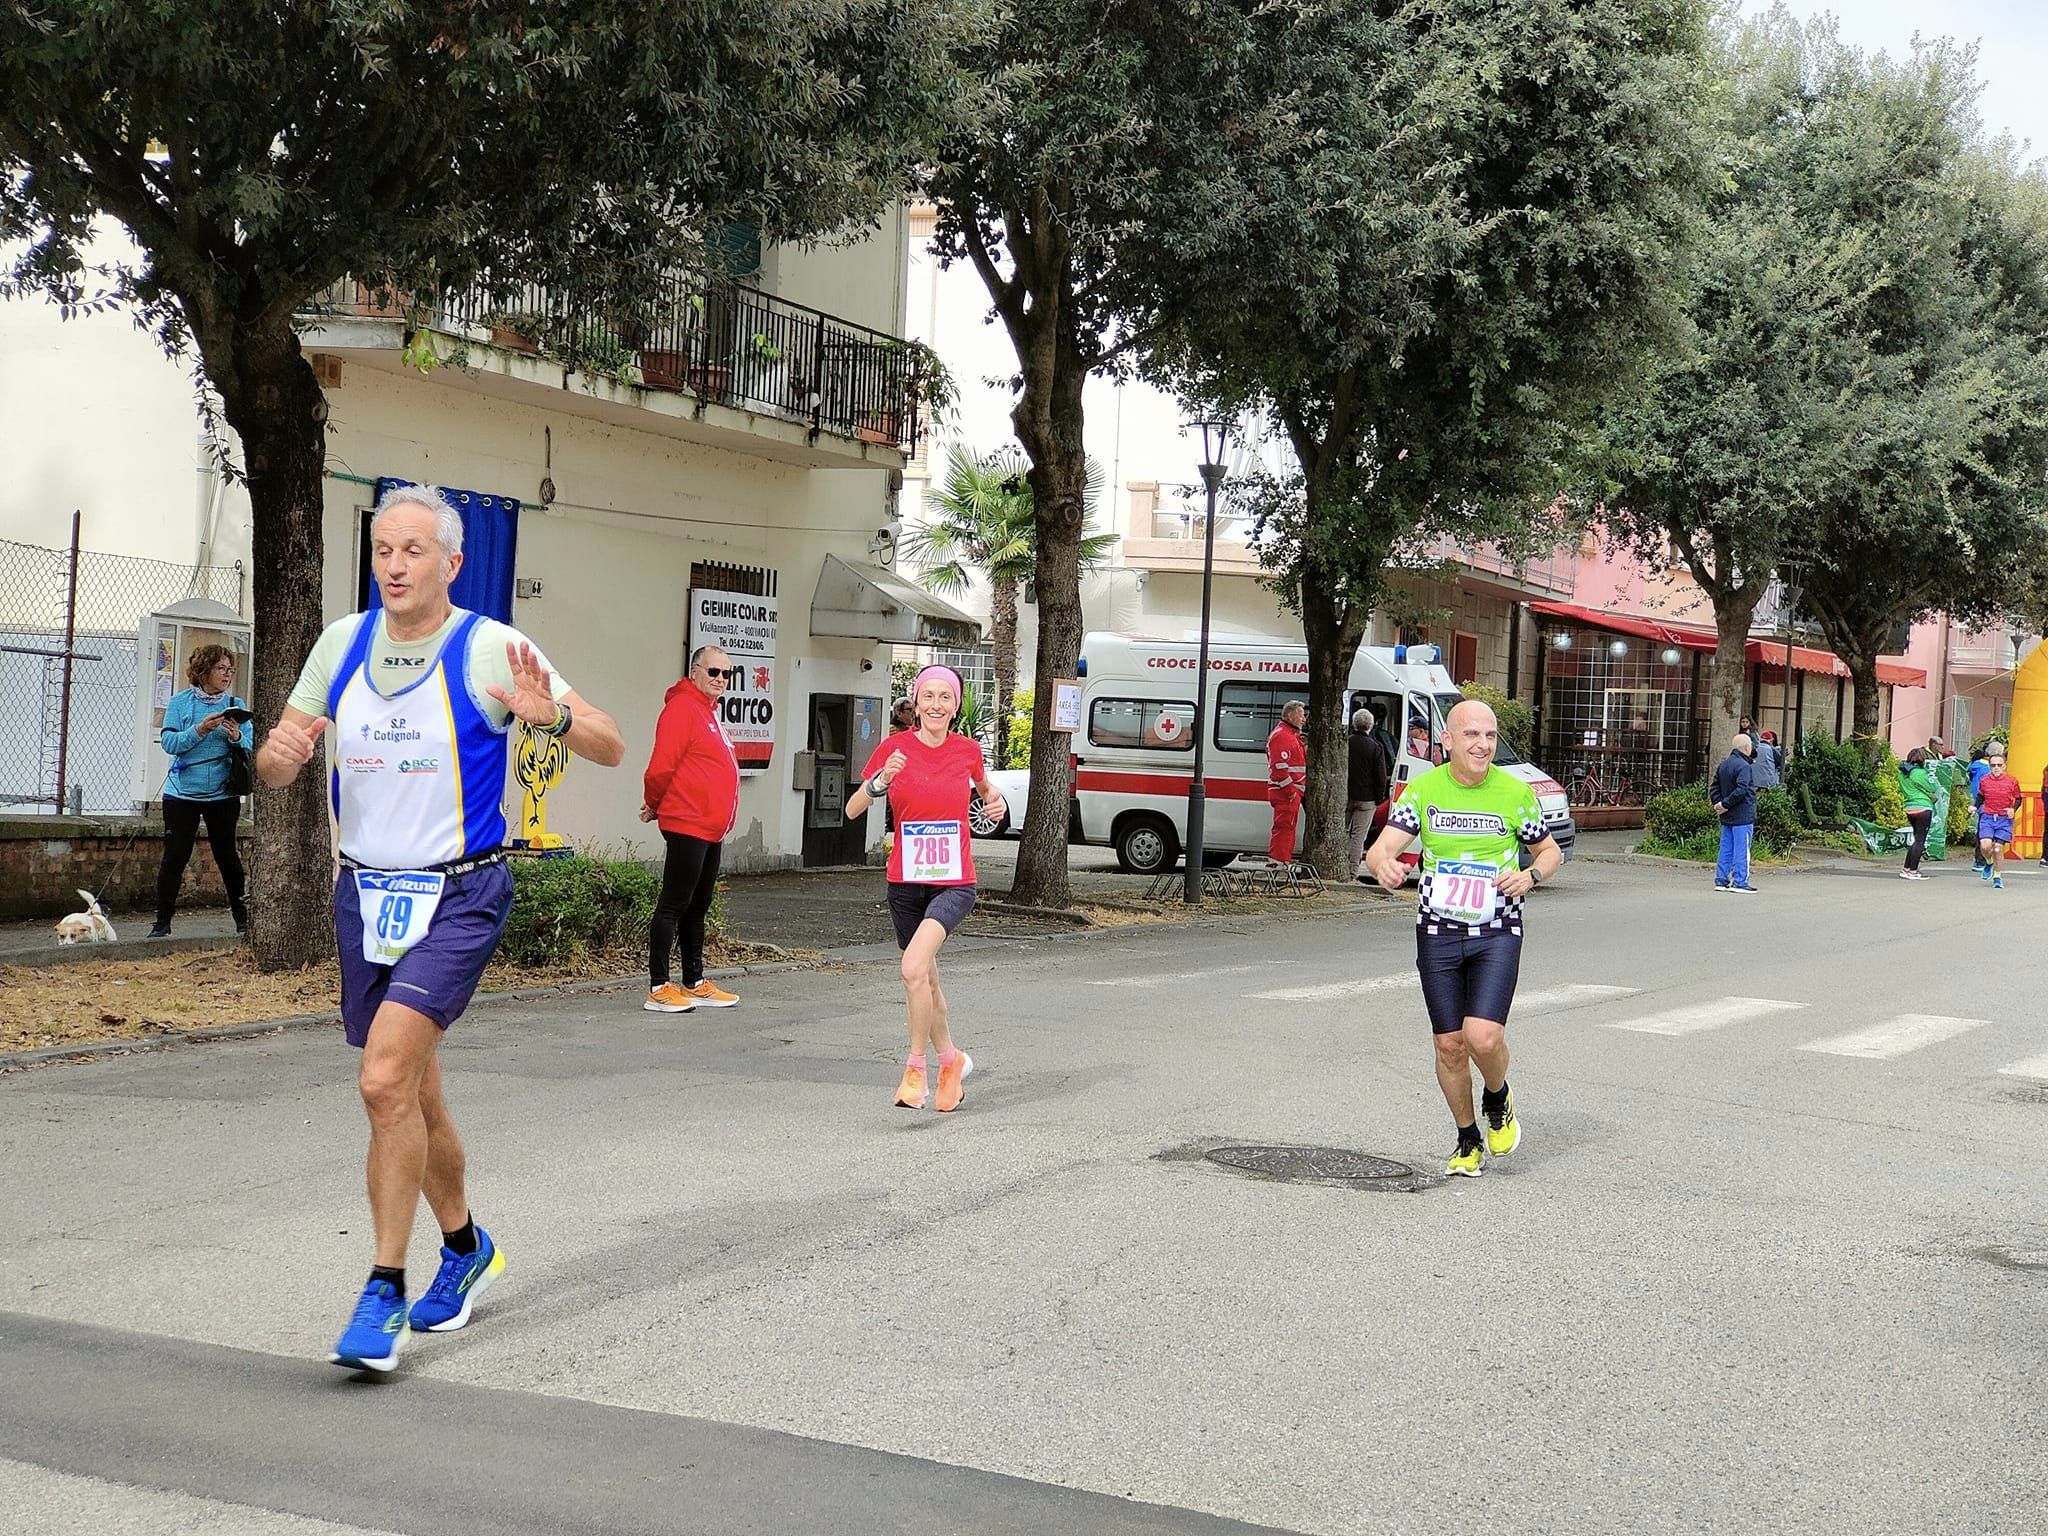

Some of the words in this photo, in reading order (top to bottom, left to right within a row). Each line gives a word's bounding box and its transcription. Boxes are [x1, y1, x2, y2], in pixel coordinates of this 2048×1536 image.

[532, 581, 541, 594] 68
[382, 656, 425, 666] SIX2
[1147, 657, 1197, 669] CROCE
[373, 730, 421, 743] Cotignola
[346, 757, 385, 765] CMCA
[412, 758, 439, 767] BCC
[913, 836, 950, 865] 286
[1445, 876, 1486, 909] 270
[376, 895, 413, 940] 89
